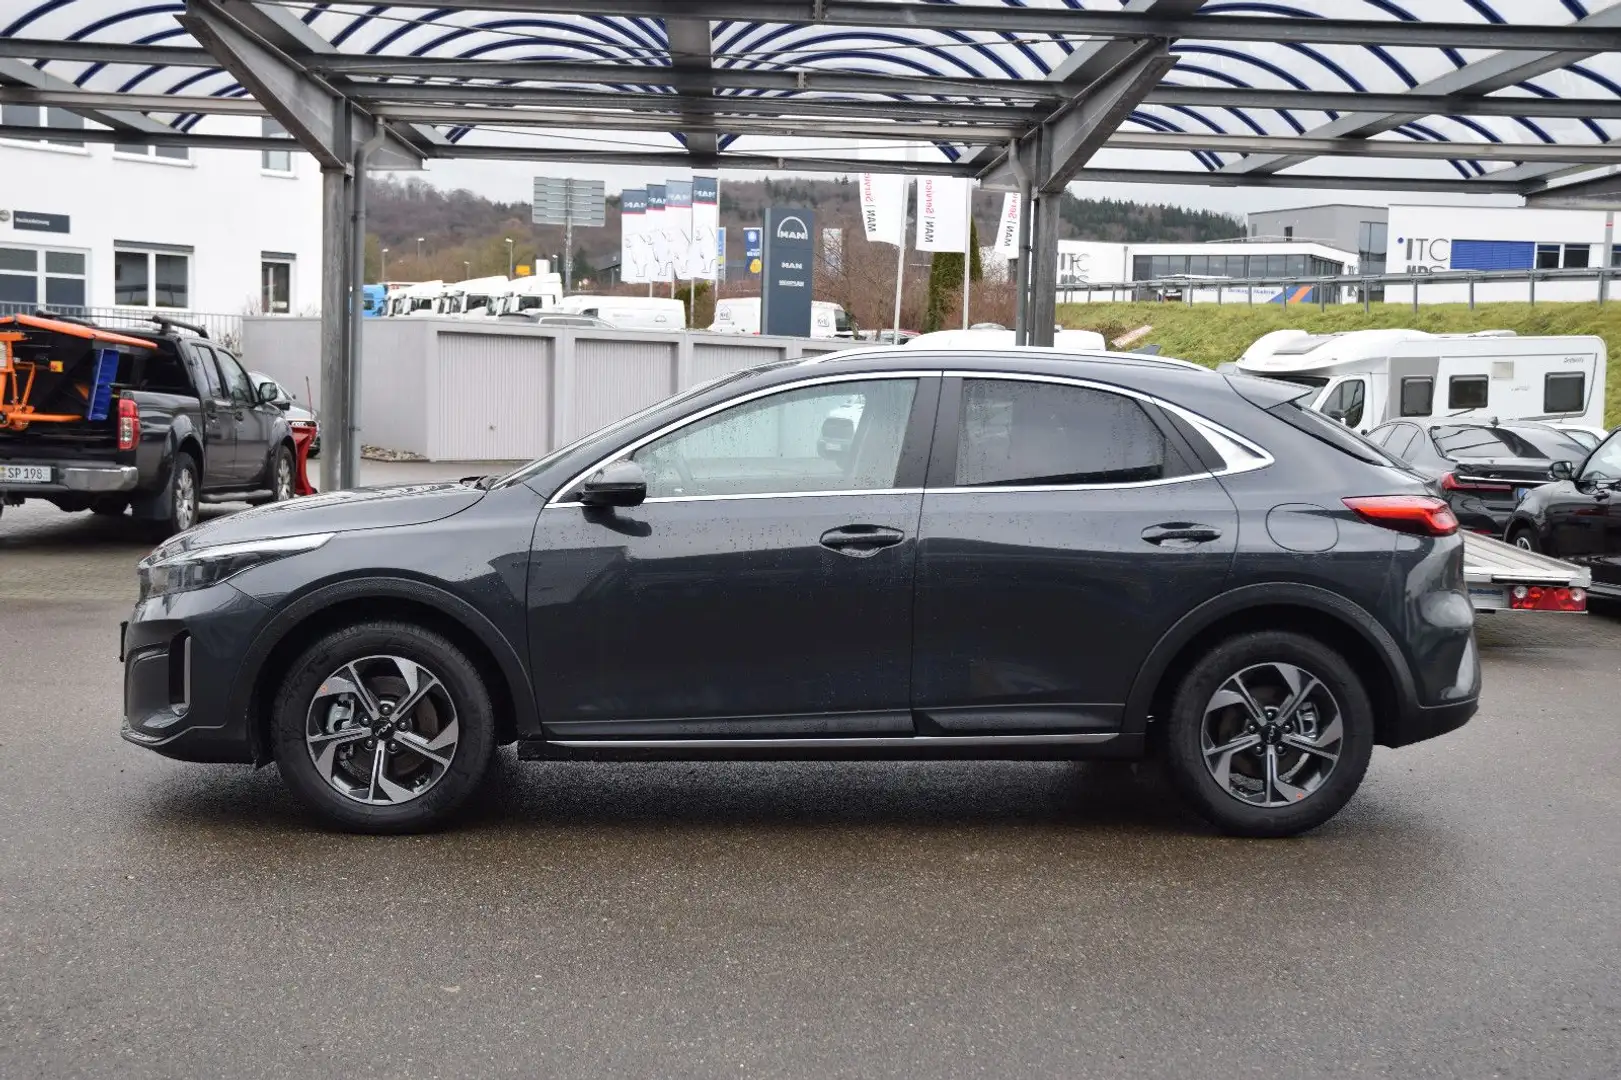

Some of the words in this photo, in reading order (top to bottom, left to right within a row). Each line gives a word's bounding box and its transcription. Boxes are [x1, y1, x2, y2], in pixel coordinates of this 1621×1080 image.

[780, 230, 808, 240] MAN
[1406, 238, 1449, 261] ITC
[781, 261, 803, 270] MAN
[1061, 252, 1090, 272] ITC
[8, 467, 21, 479] SP
